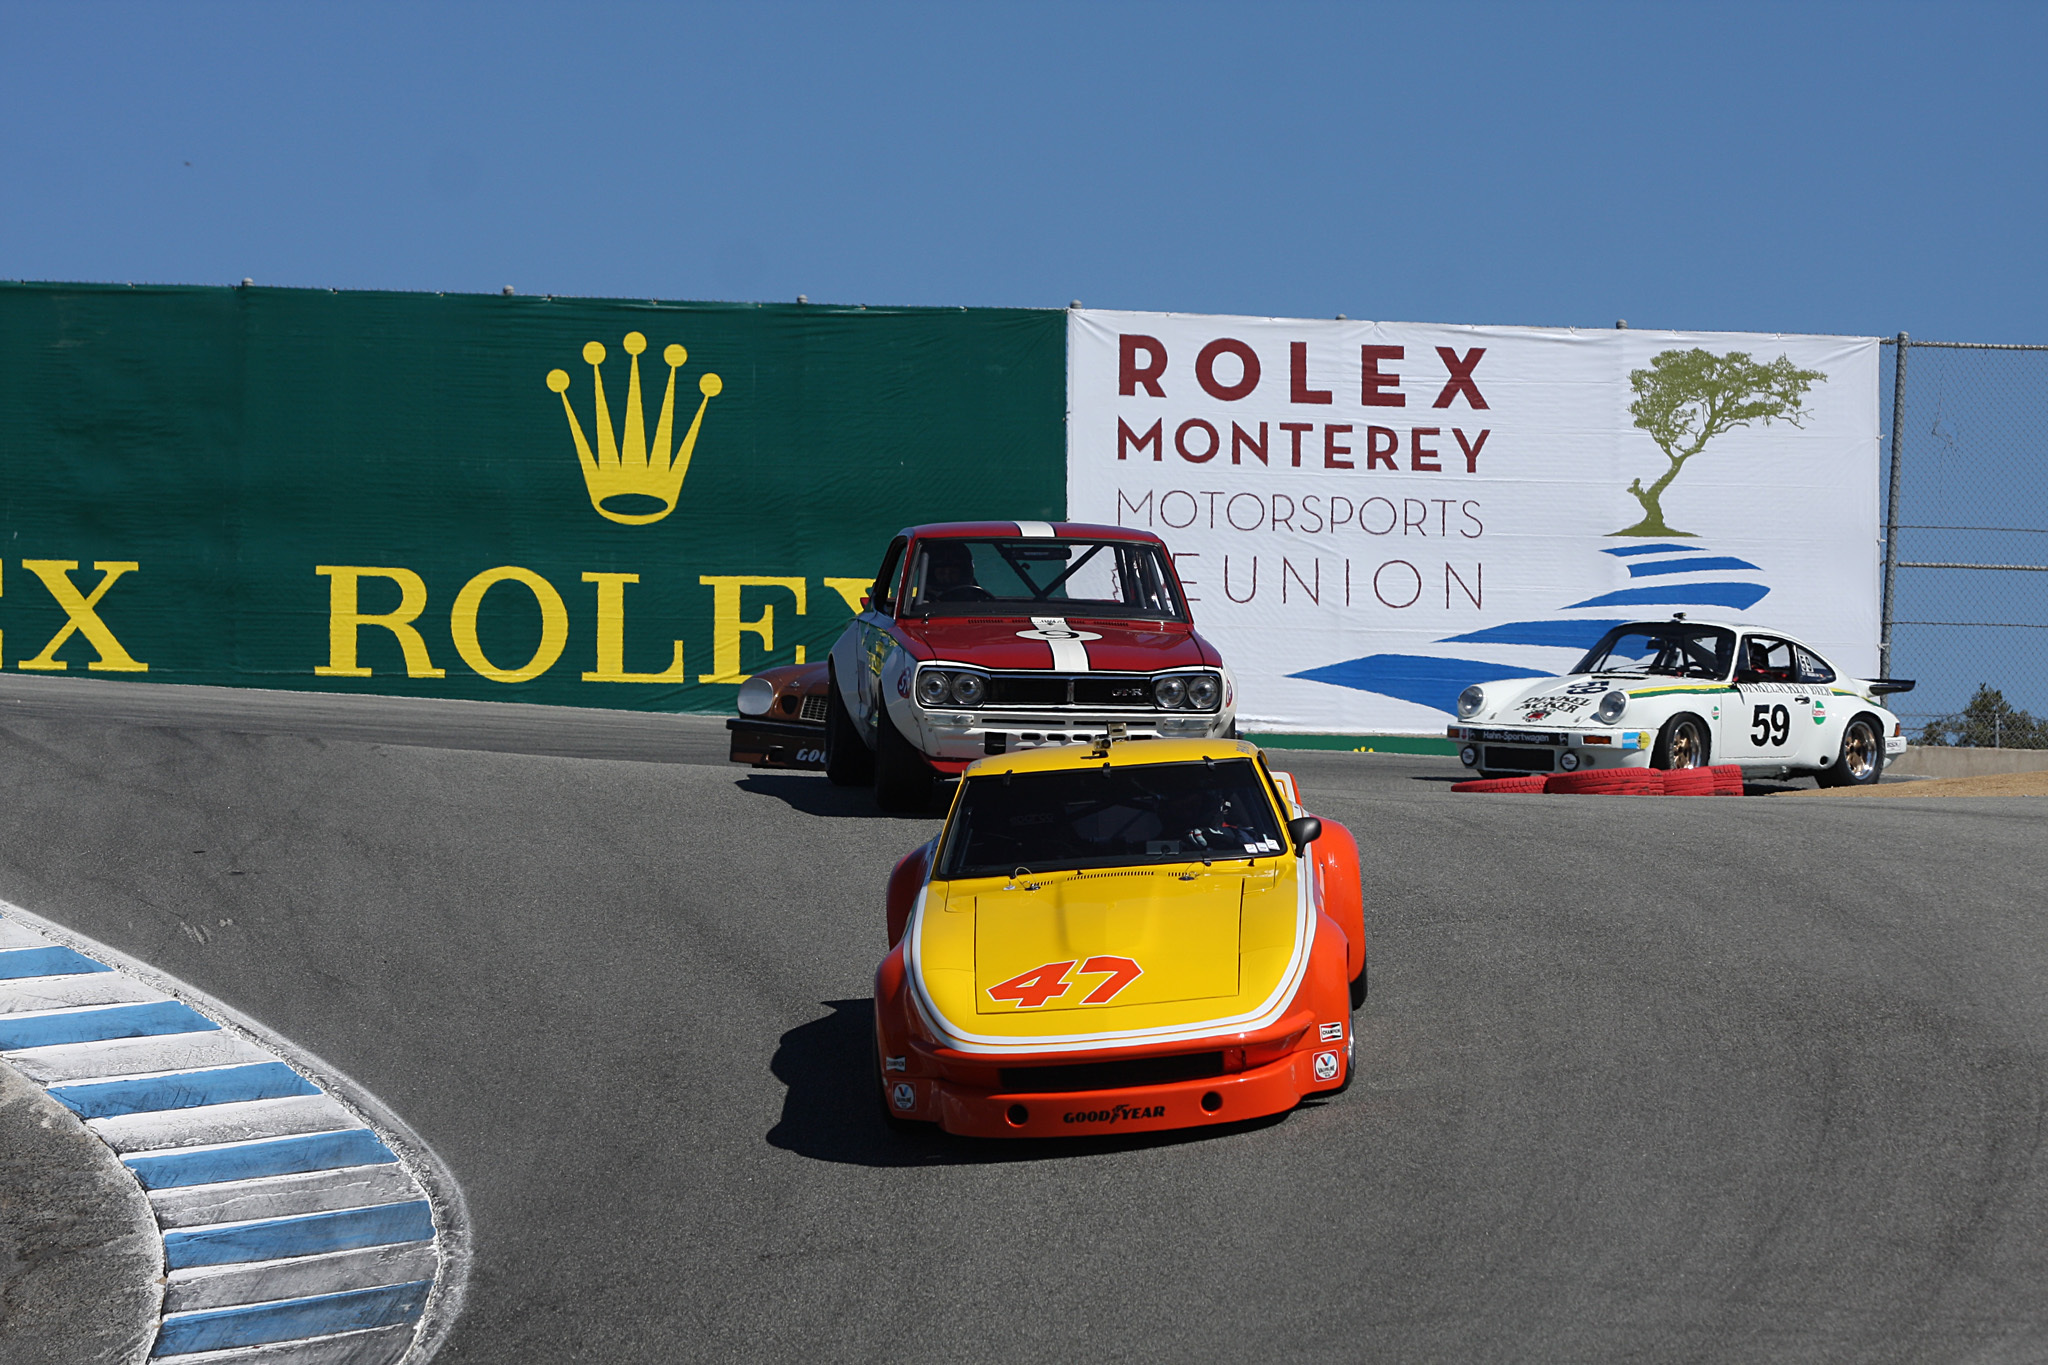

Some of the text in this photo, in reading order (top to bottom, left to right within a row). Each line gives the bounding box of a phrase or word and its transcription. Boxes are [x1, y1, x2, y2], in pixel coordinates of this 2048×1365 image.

[1118, 333, 1491, 410] ROLEX
[1117, 415, 1492, 474] MONTEREY
[1117, 487, 1484, 539] MOTORSPORTS
[1166, 552, 1483, 611] EUNION
[1799, 655, 1813, 672] 59
[1483, 731, 1550, 744] Hahn-Sportwagen
[1750, 703, 1790, 748] 59
[985, 954, 1145, 1009] 47
[1063, 1104, 1166, 1124] GOODYEAR
